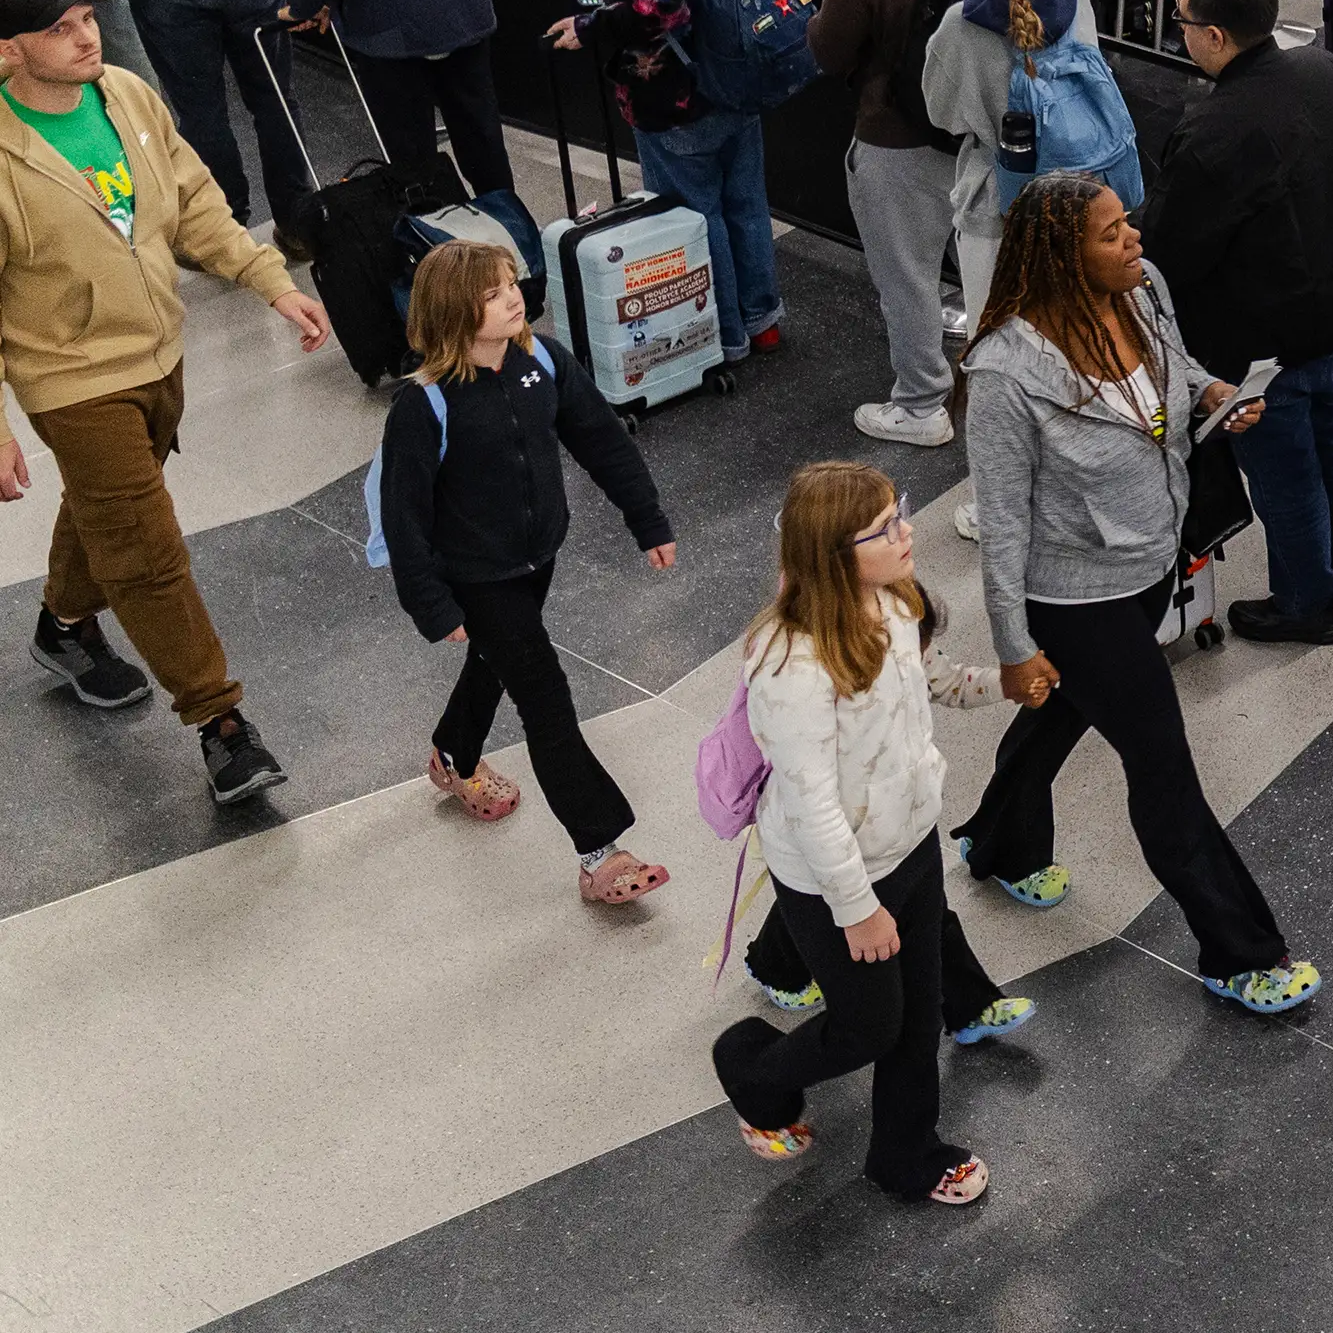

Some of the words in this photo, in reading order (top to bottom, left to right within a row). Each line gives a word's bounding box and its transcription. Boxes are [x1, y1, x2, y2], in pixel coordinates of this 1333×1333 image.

[626, 265, 686, 290] RADIOHEAD!
[644, 288, 668, 300] PROUD
[669, 277, 692, 291] PARENT
[680, 276, 707, 292] ACADEMY
[646, 301, 669, 312] HONOR
[670, 296, 684, 304] ROLL
[684, 283, 707, 297] STUDENT
